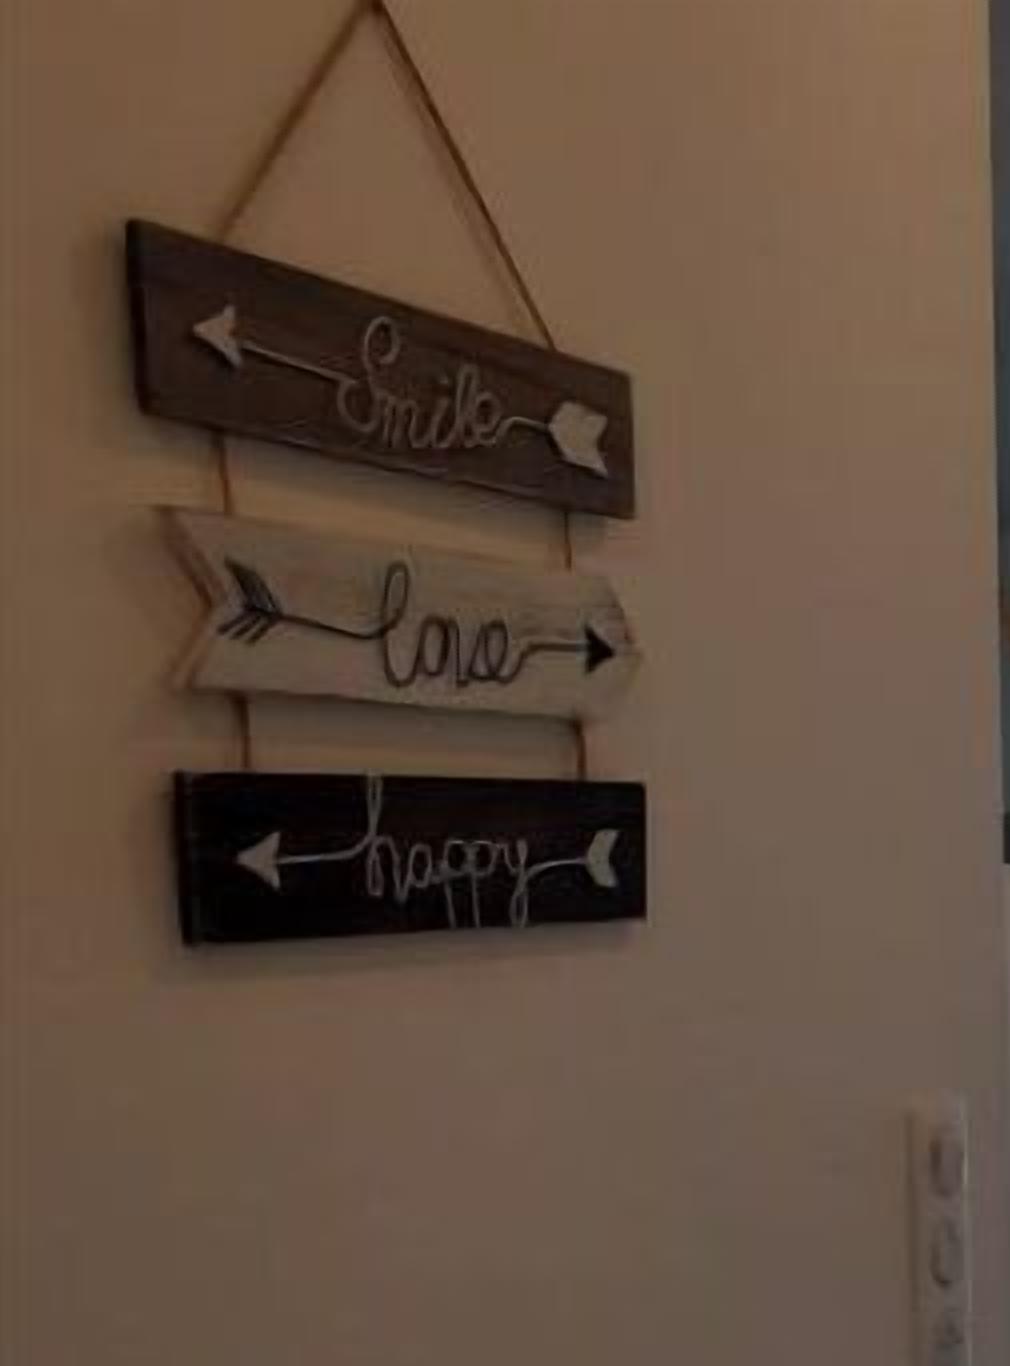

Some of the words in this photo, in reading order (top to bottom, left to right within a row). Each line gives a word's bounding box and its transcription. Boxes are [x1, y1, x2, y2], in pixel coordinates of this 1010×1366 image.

[336, 315, 501, 449] Smile
[380, 560, 524, 688] love
[365, 771, 529, 929] happy
